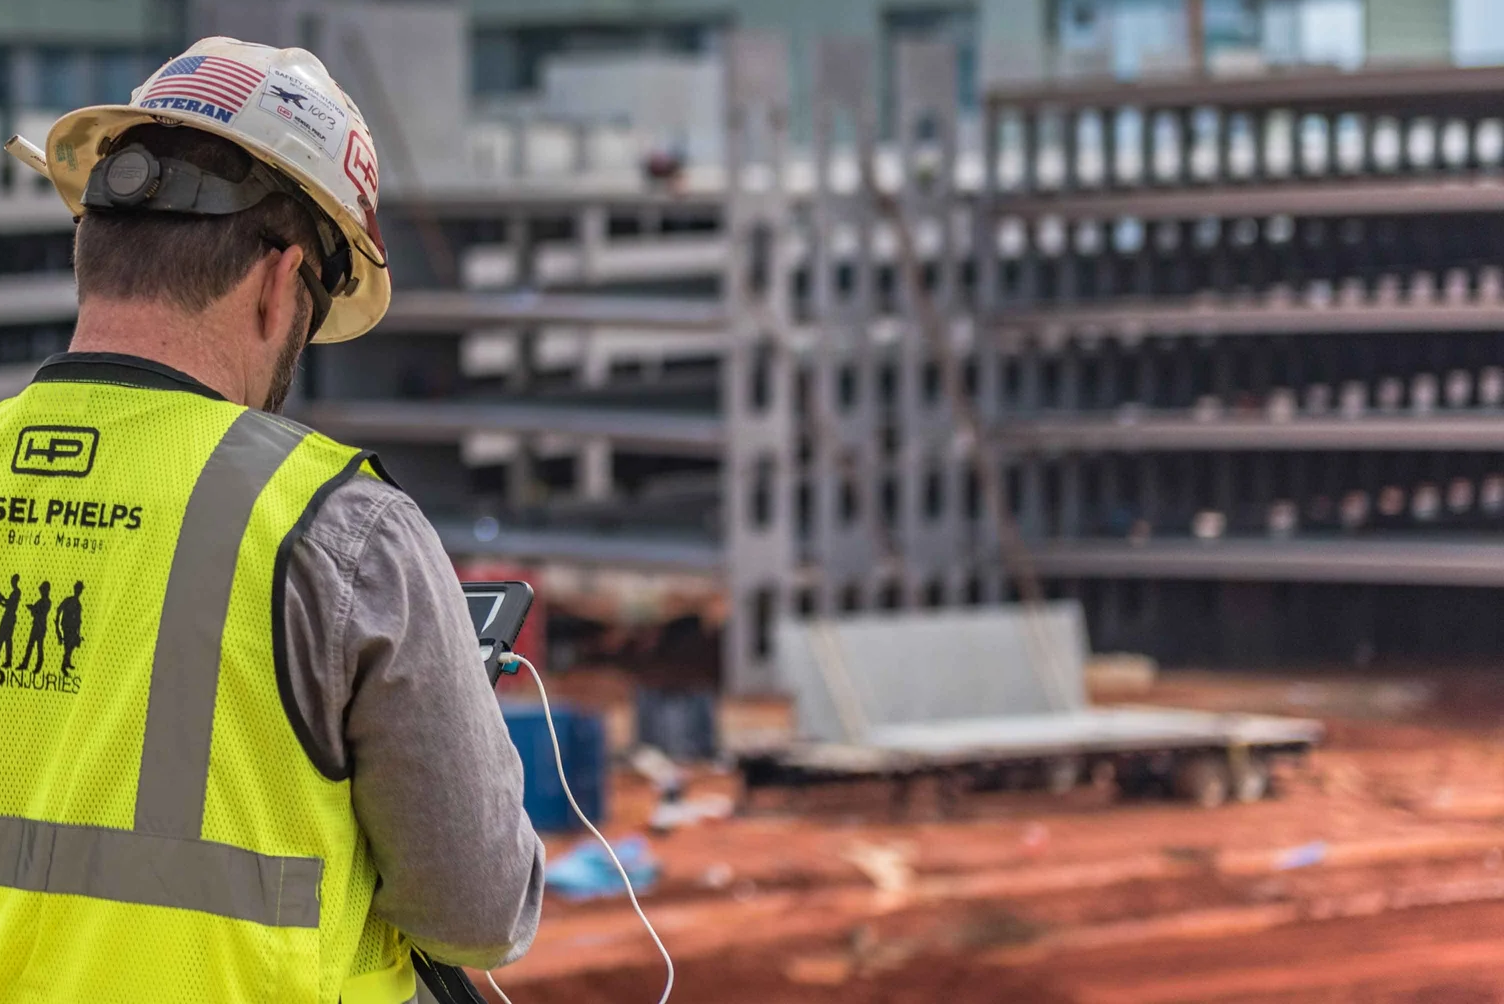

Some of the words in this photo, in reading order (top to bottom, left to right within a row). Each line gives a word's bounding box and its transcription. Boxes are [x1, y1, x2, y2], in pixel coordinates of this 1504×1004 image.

[275, 70, 303, 86] SAFETY
[140, 97, 233, 123] VETERAN
[308, 105, 336, 131] 1003
[111, 168, 142, 180] MSA
[24, 438, 84, 462] HP
[45, 499, 143, 530] PHELPS
